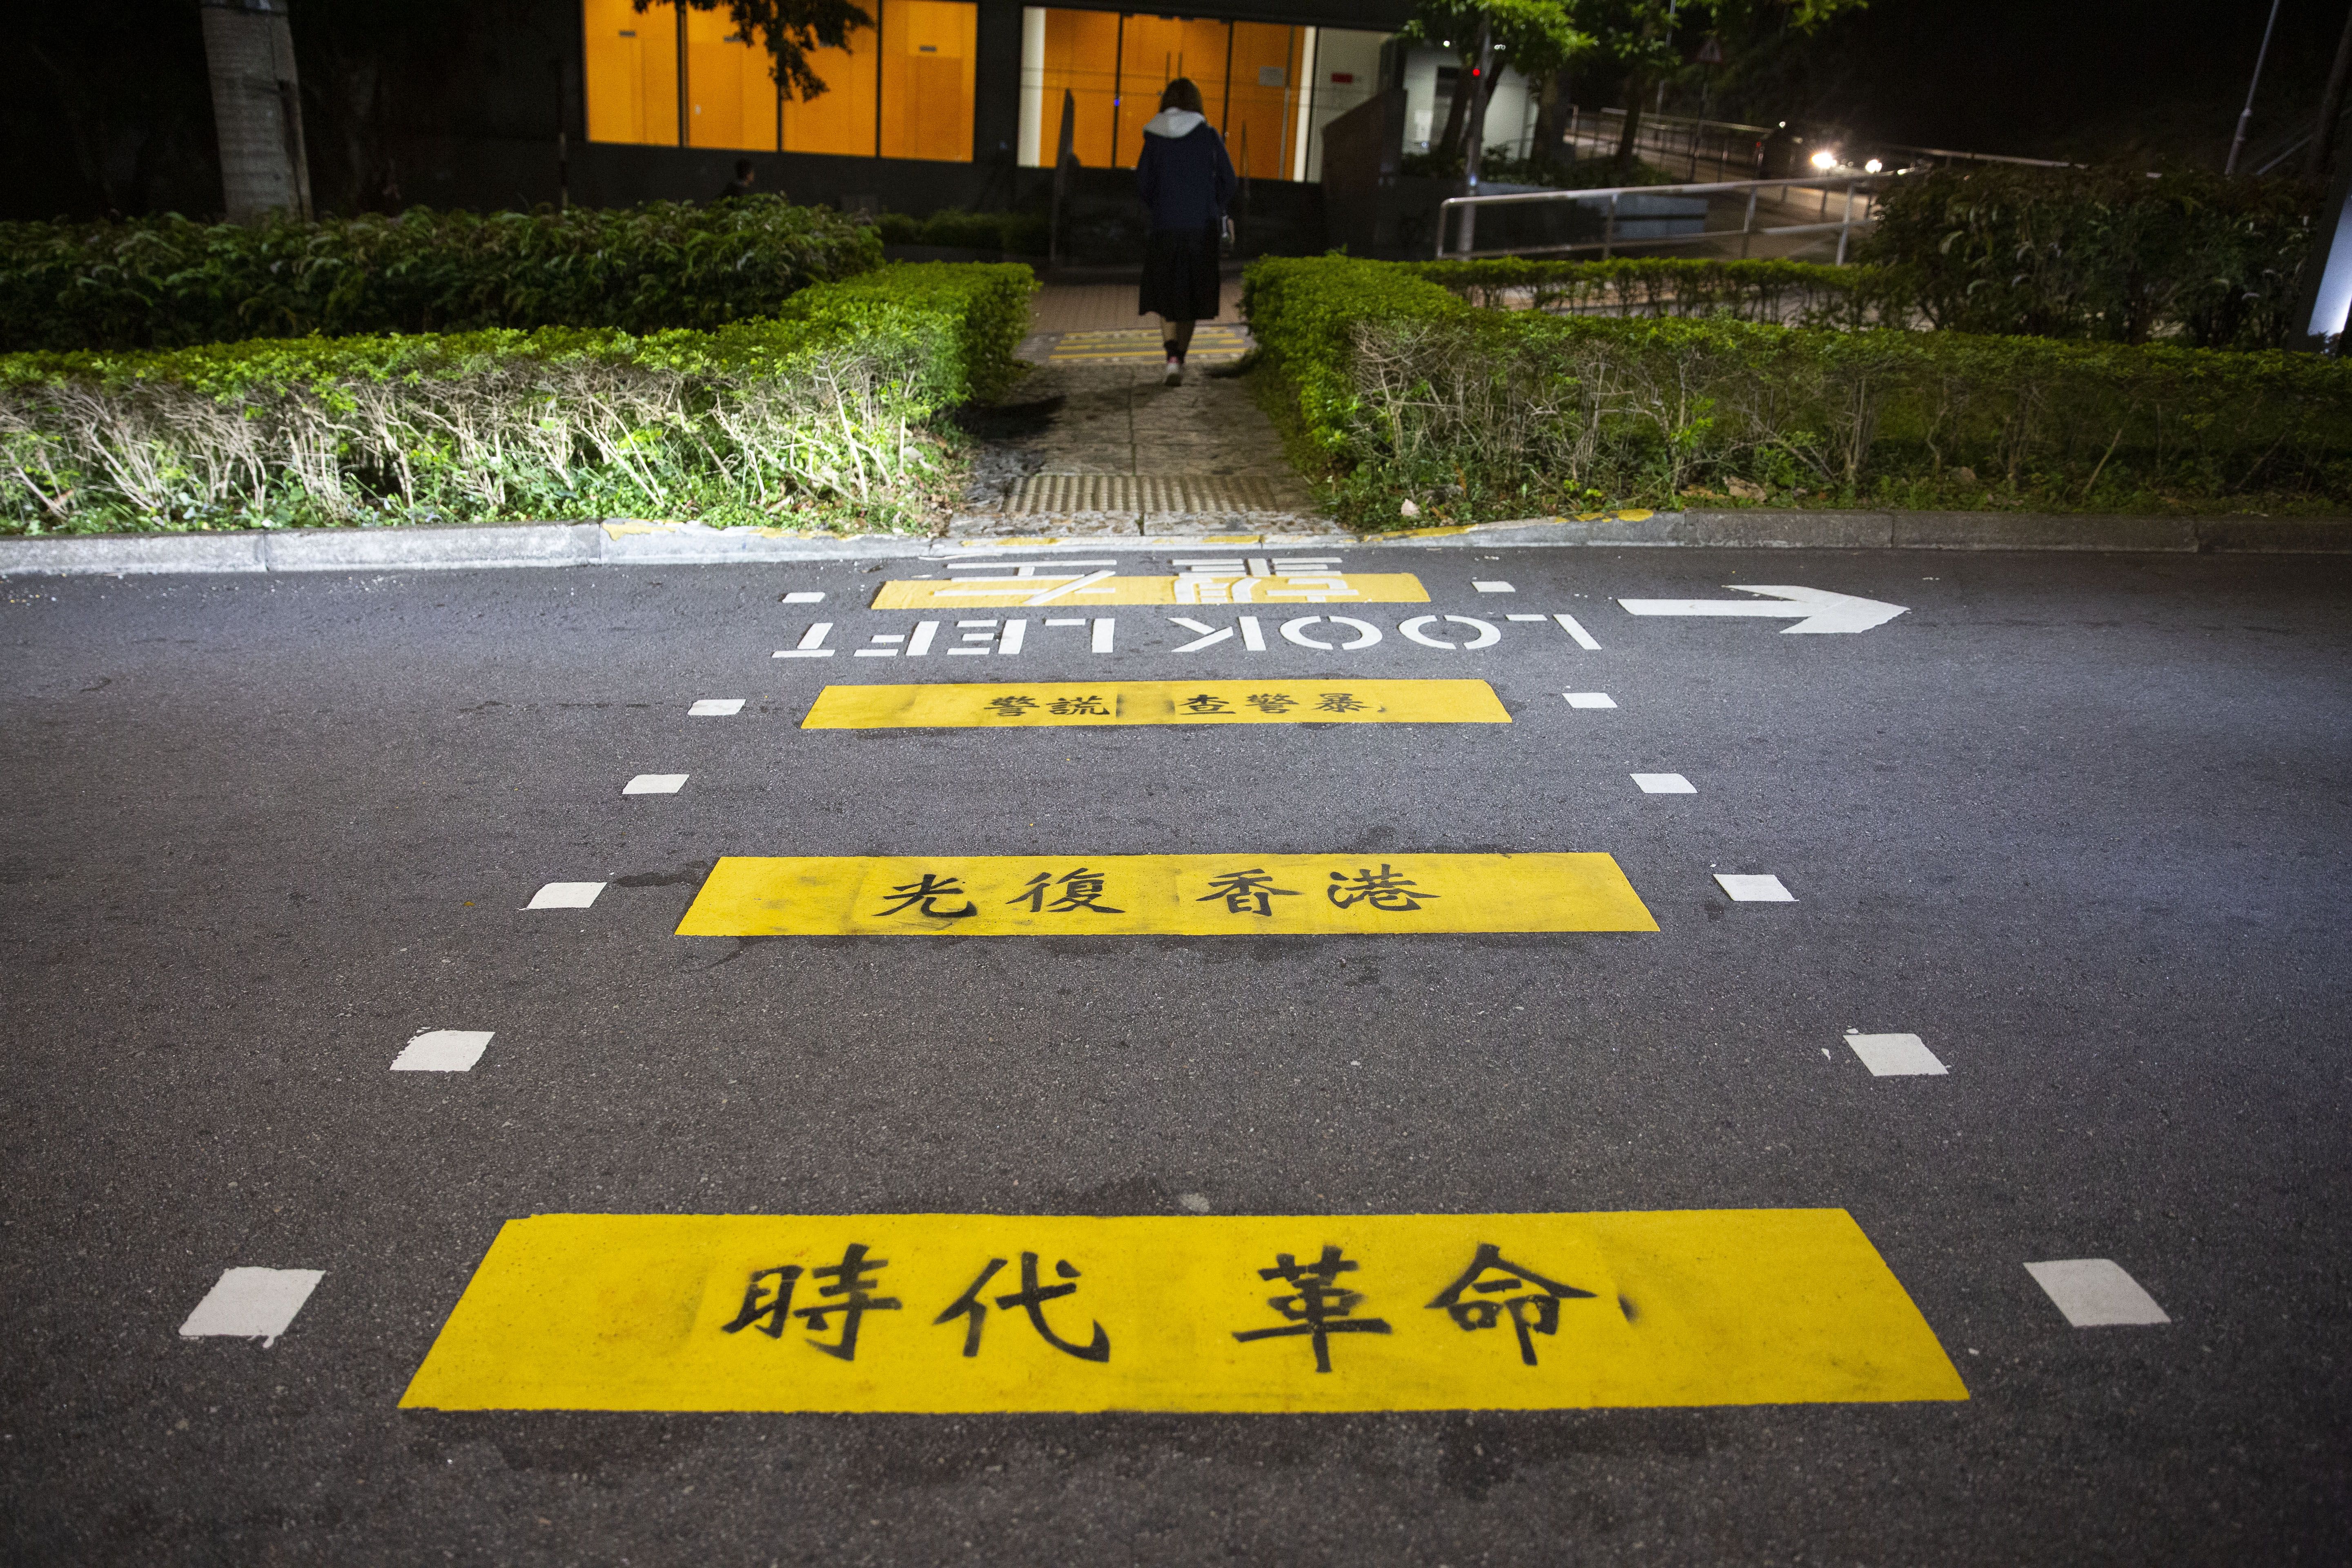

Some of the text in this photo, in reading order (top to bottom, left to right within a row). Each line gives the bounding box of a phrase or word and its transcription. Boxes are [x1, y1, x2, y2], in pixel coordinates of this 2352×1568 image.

[934, 557, 1360, 606] 望左
[771, 614, 1603, 658] LOOK LEFT
[872, 863, 1441, 918] 光復香港
[721, 1243, 1598, 1374] 時代革命
